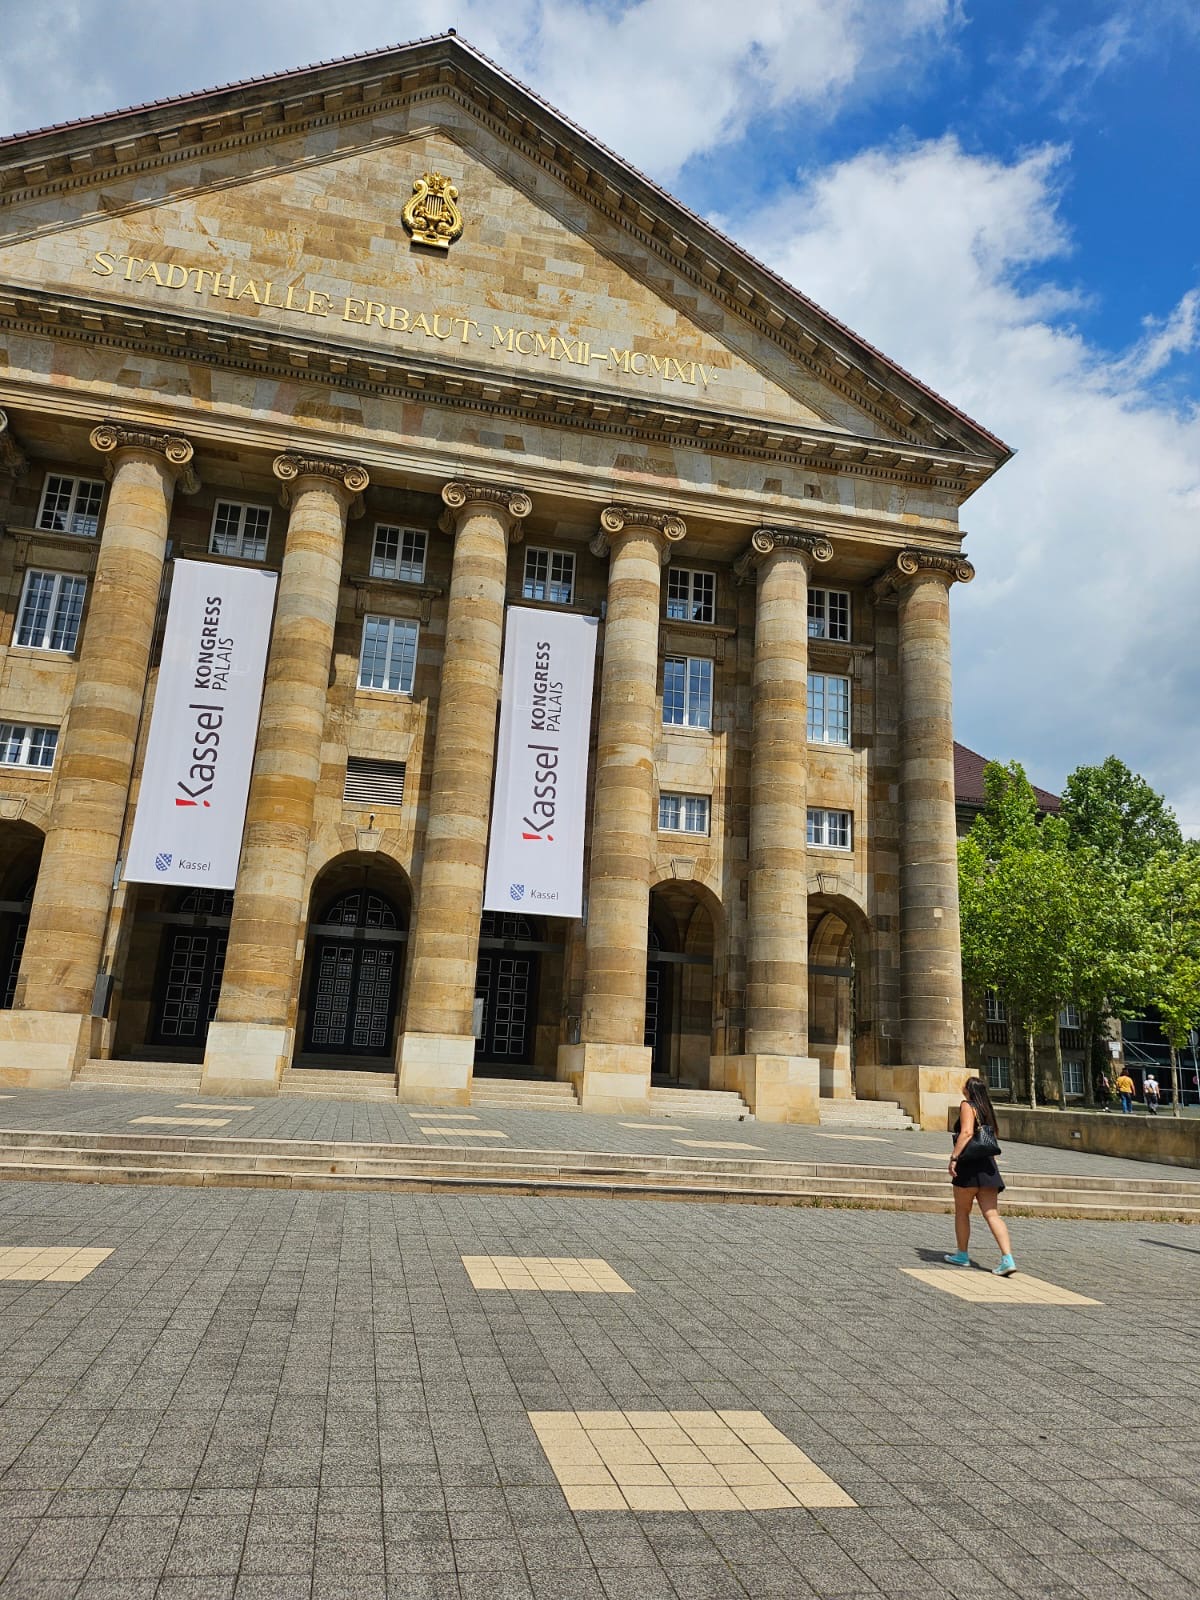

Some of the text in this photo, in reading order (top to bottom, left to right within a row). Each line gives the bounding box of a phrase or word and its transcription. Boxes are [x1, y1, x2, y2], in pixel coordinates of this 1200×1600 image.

[194, 596, 222, 689] KONGRESS
[212, 637, 234, 691] PALAIS
[531, 641, 551, 731] KONGRESS
[546, 681, 564, 732] PALAIS
[178, 859, 211, 871] Kassel
[530, 888, 559, 901] Kassel
